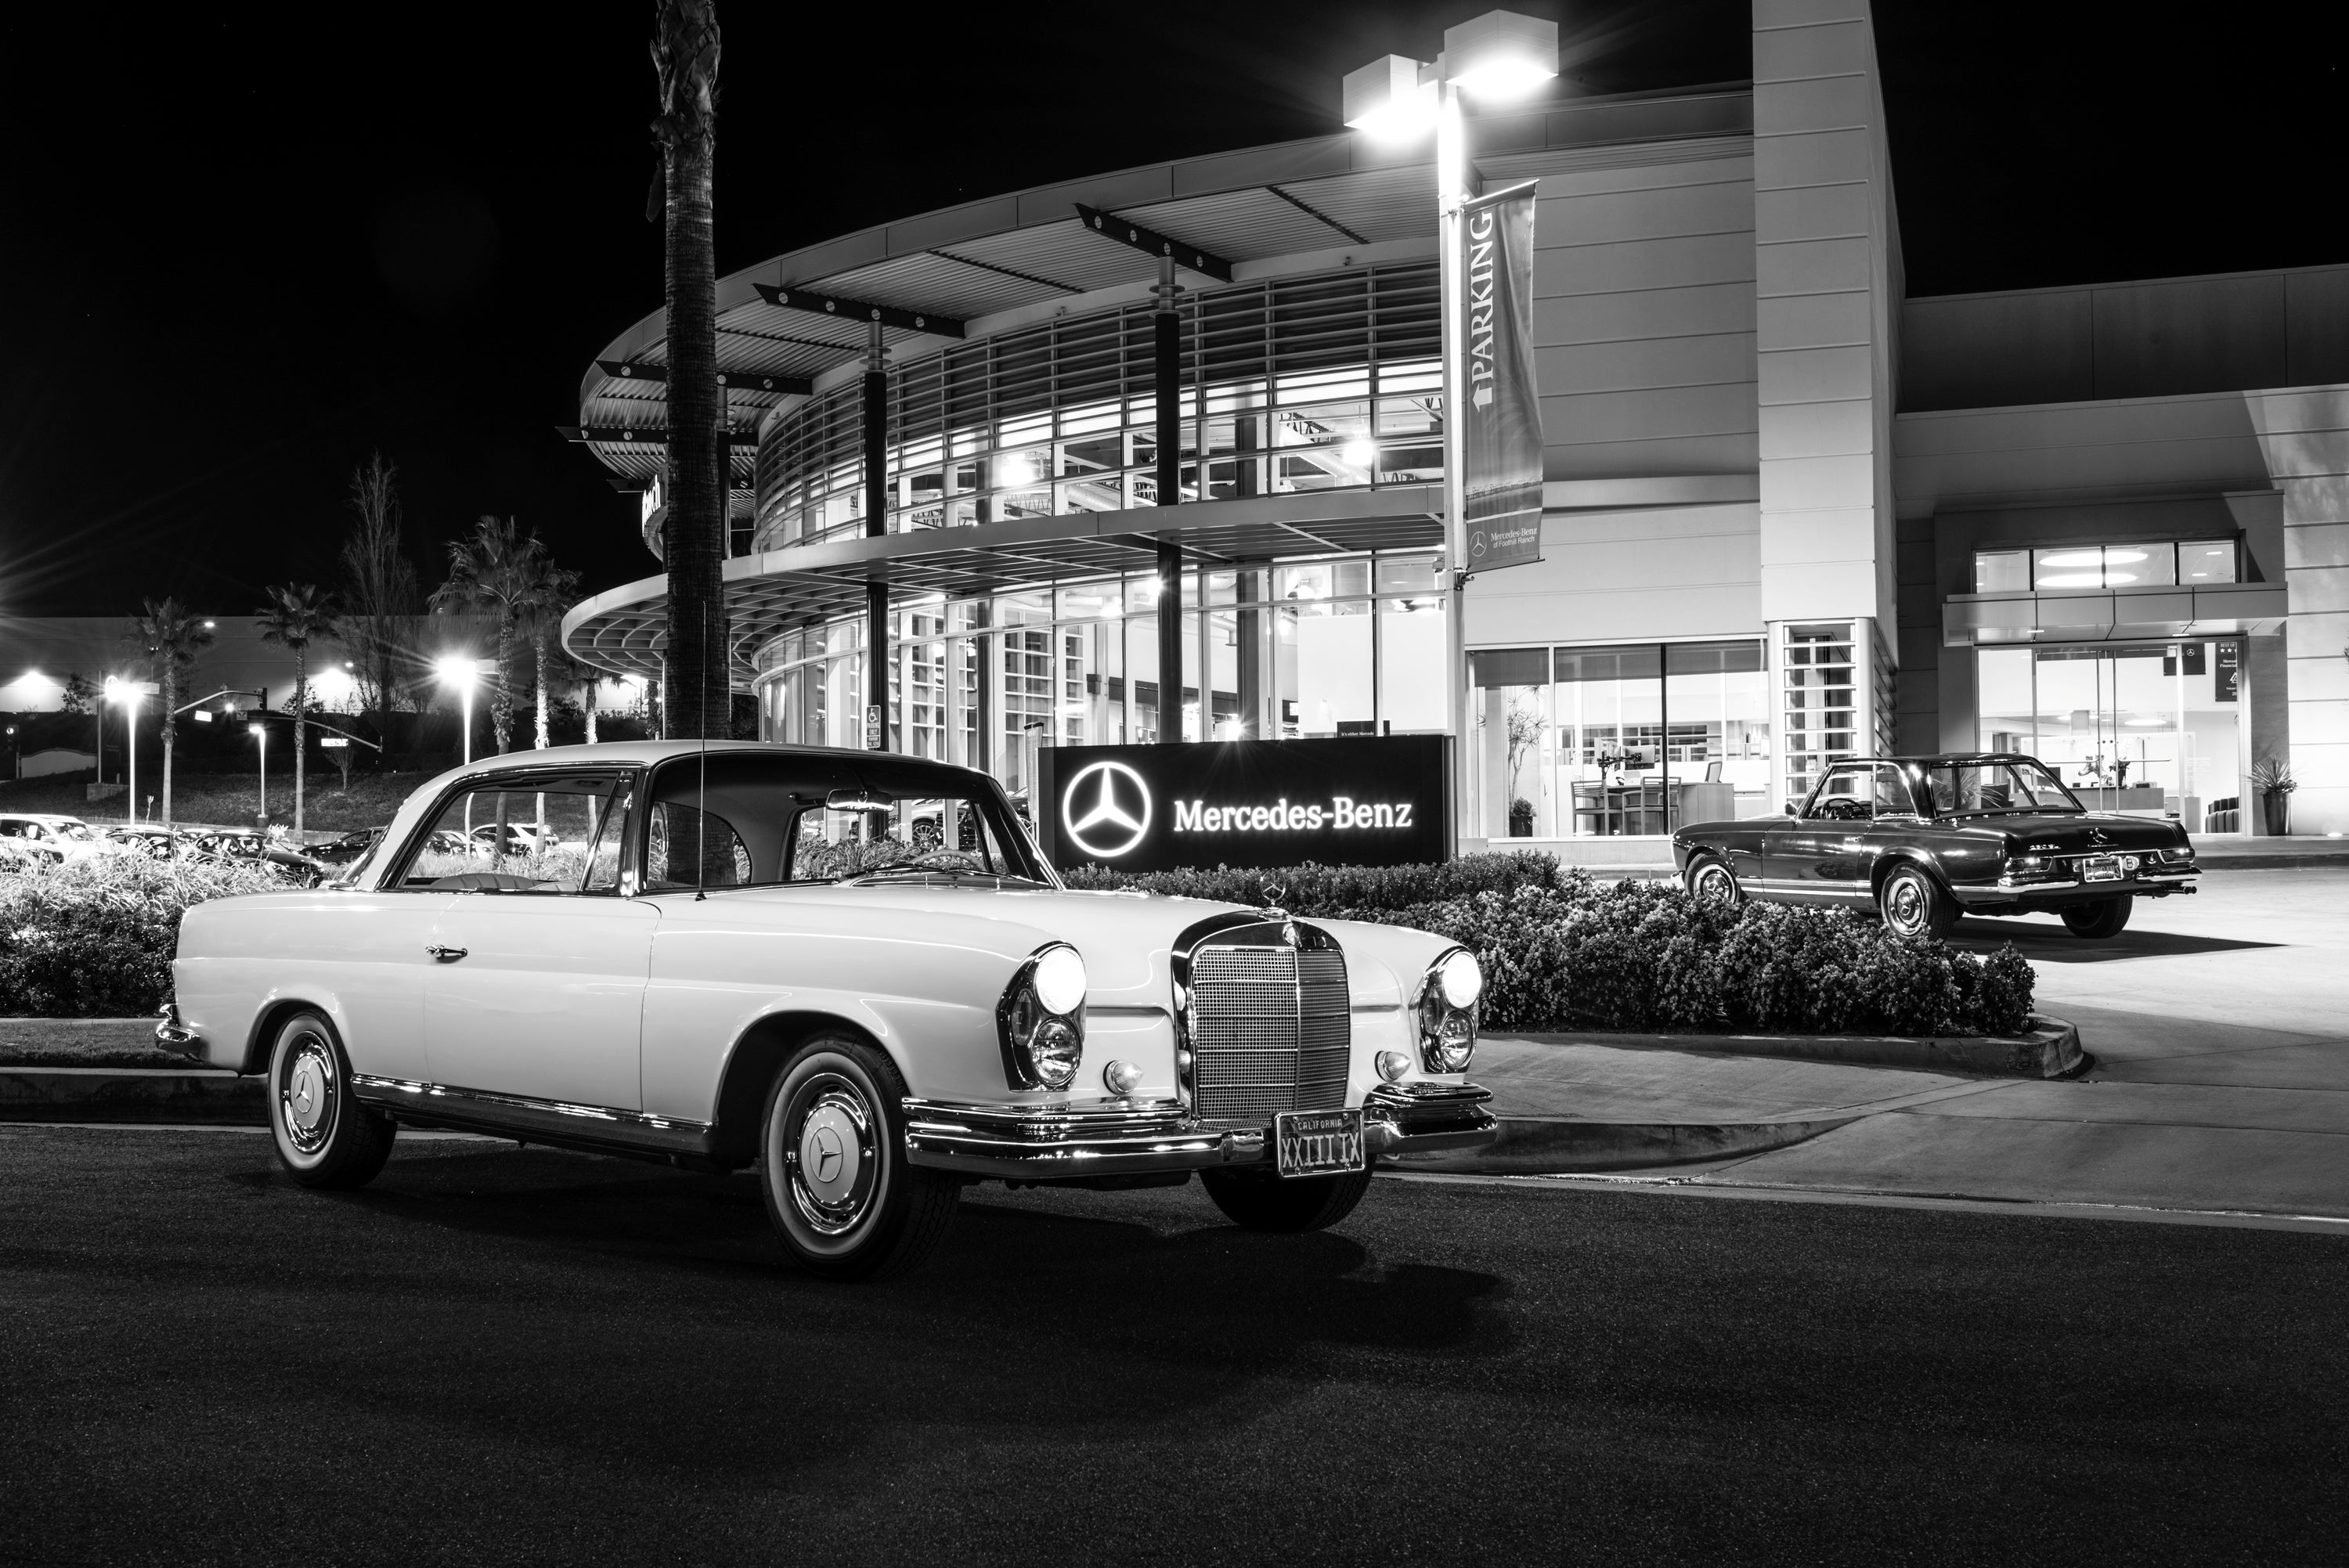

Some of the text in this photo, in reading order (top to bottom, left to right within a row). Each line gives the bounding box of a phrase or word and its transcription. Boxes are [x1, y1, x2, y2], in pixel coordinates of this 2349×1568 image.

[1470, 212, 1493, 384] PARKING
[1490, 528, 1538, 542] Mercedes-Benz
[1499, 538, 1517, 547] Foothill
[1517, 535, 1535, 544] Ranch
[1173, 797, 1413, 831] Mercedes-Benz
[2127, 858, 2134, 869] B
[1297, 1119, 1343, 1130] CALIFORNIA
